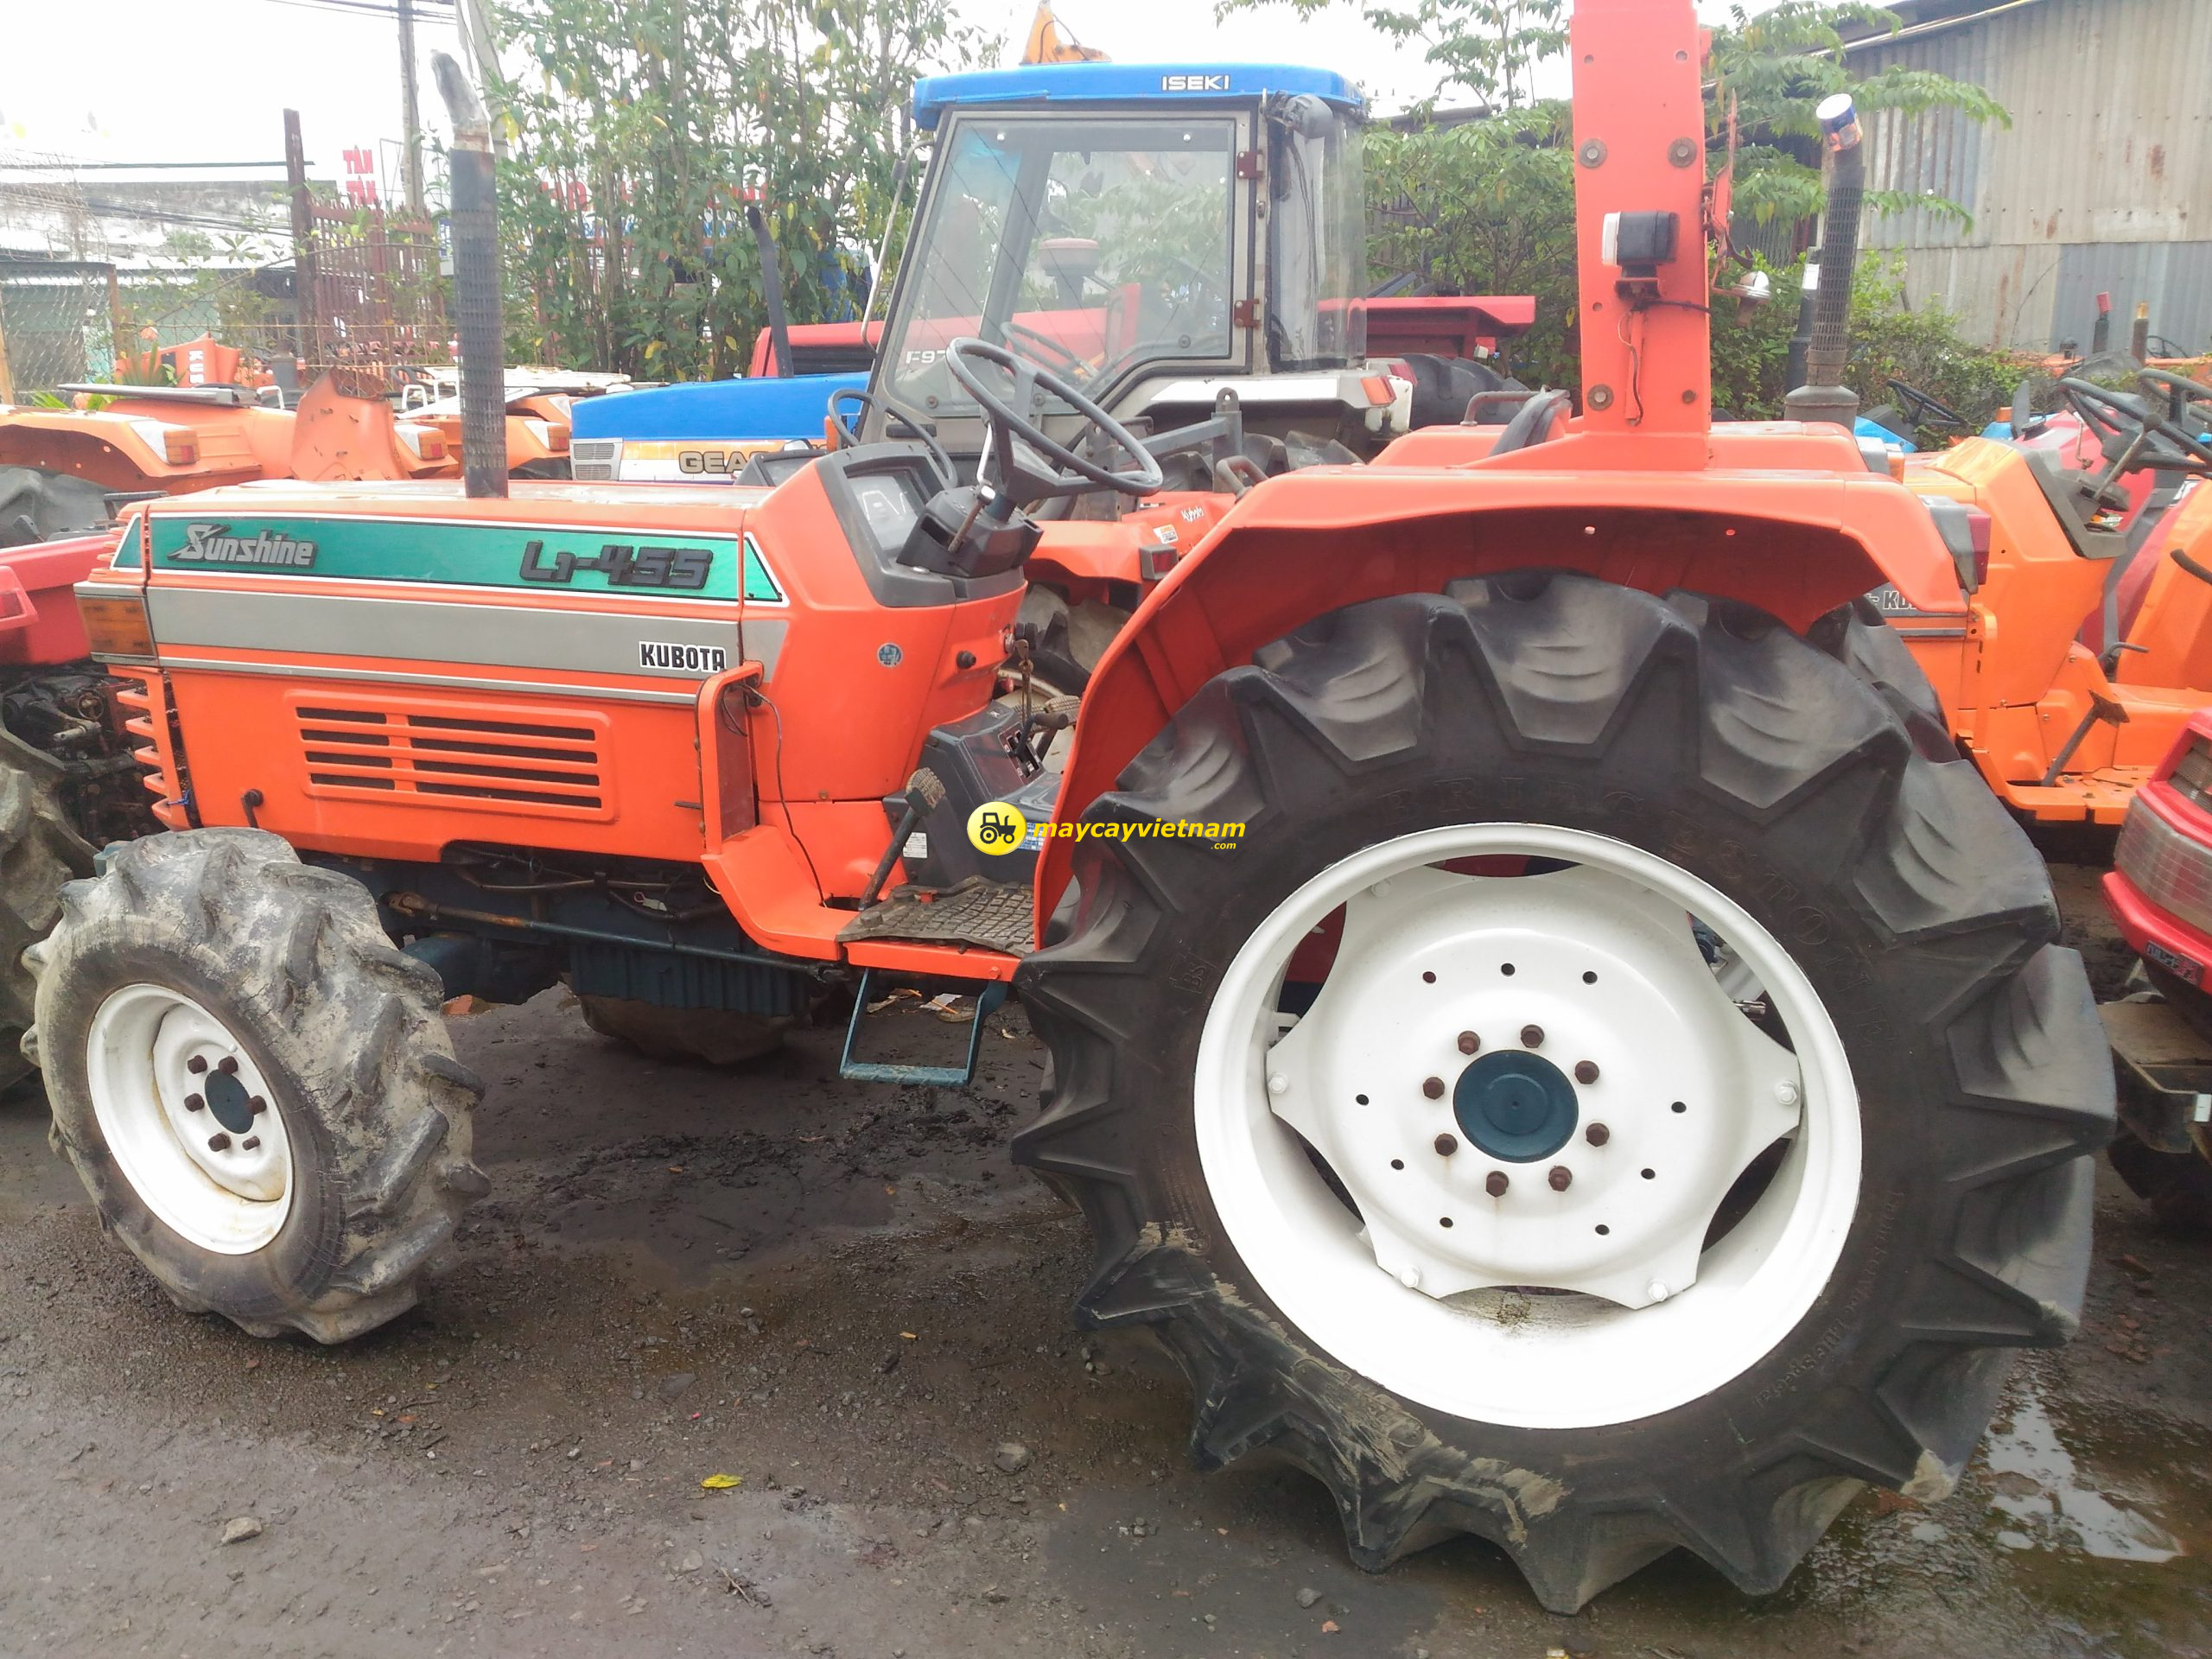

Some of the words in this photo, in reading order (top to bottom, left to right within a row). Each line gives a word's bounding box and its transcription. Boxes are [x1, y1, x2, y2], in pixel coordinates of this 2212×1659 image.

[1161, 74, 1230, 91] ISEKI
[679, 451, 768, 474] GEA
[167, 523, 317, 568] Sunshine
[640, 643, 725, 671] KUBOTA
